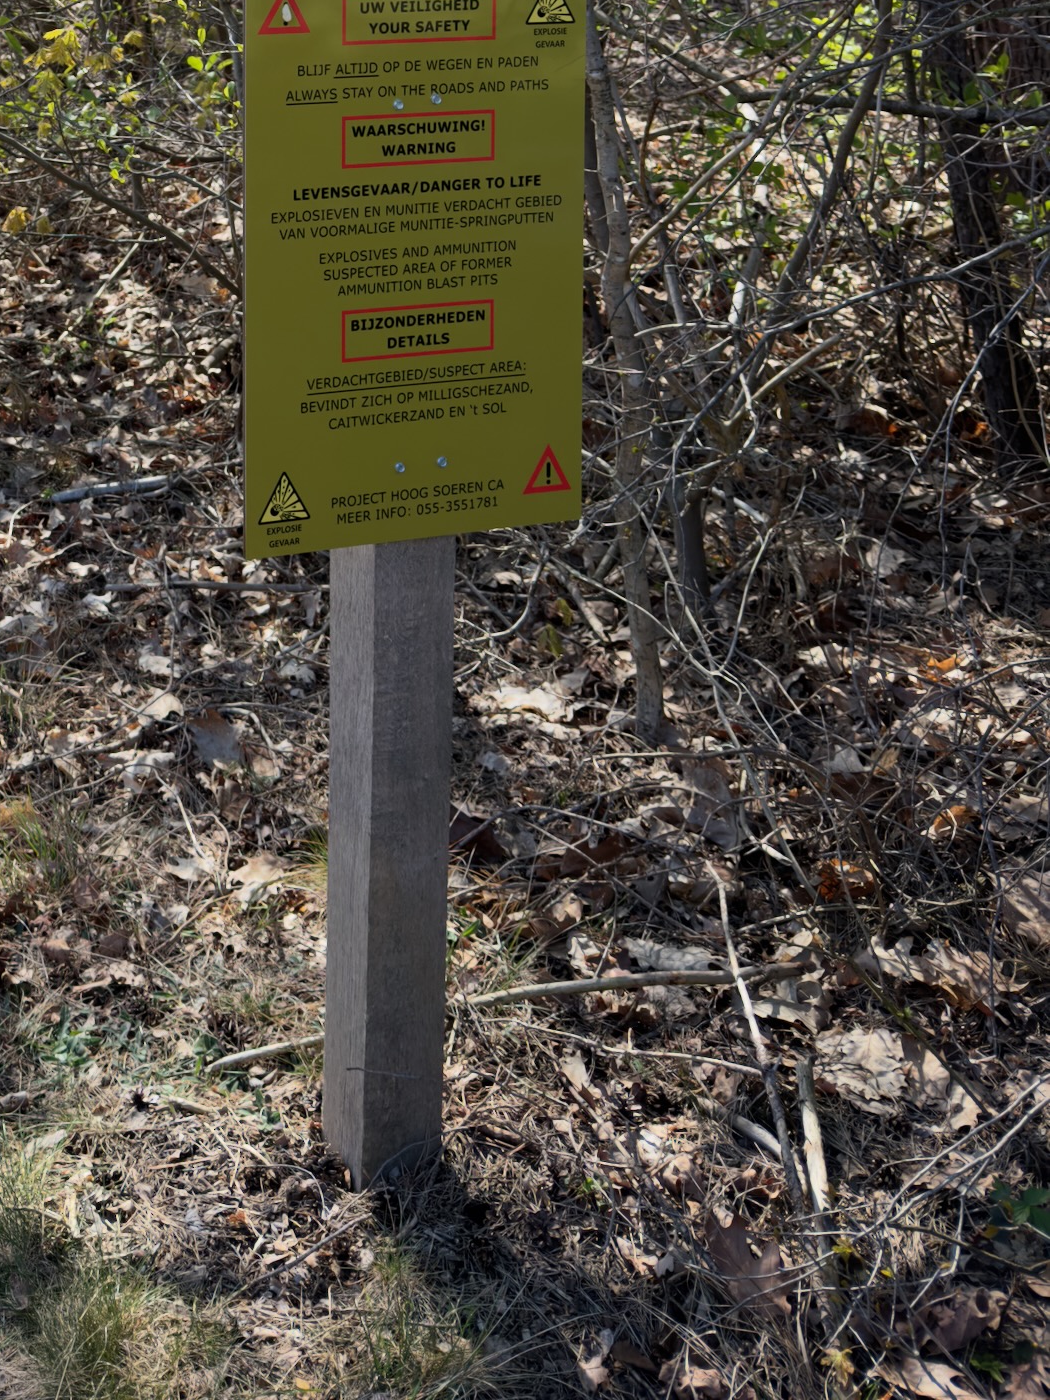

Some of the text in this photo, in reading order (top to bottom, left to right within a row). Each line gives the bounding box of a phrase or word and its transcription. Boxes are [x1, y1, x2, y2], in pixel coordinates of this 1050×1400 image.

[360, 0, 480, 14] UW VEILIGHEID
[369, 20, 471, 35] YOUR SAFETY
[533, 28, 567, 36] EXPLOSIE
[535, 40, 565, 48] GEVAAR
[297, 56, 539, 77] BLIJF ALTIJD OP DE WEGEN EN PADEN
[286, 79, 549, 102] ALWAYS STAY ON THE ROADS AND PATHS
[351, 120, 486, 138] WAARSCHUWING!
[381, 142, 456, 157] WARNING
[293, 175, 541, 201] LEVENSGEVAAR/DANGER TO LIFE
[270, 195, 562, 224] EXPLOSIEVEN EN MUNITIE VERDACHT GEBIED
[279, 212, 554, 241] VAN VOORMALIGE MUNITIE-SPRINGPUTTEN
[319, 240, 517, 265] EXPLOSIVES AND AMMUNITION
[323, 256, 512, 281] SUSPECTED AREA OF FORMER
[337, 274, 498, 297] AMMUNITION BLAST PITS
[350, 310, 486, 332] BIJZONDERHEDEN
[387, 333, 451, 349] DETAILS
[307, 360, 527, 391] VERDACHTGEBIED/SUSPECT AREA:
[300, 381, 534, 414] BEVINDT ZICH OP MILLIGSCHEZAND,
[328, 408, 445, 430] CAITWICKERZAND
[449, 405, 466, 418] EN
[482, 402, 507, 415] SOL
[331, 480, 504, 509] PROJECT HOOG SOEREN CA
[337, 496, 498, 525] MEER INFO: 055-3551781
[266, 524, 302, 536] EXPLOSIE
[269, 537, 300, 548] GEVAAR
